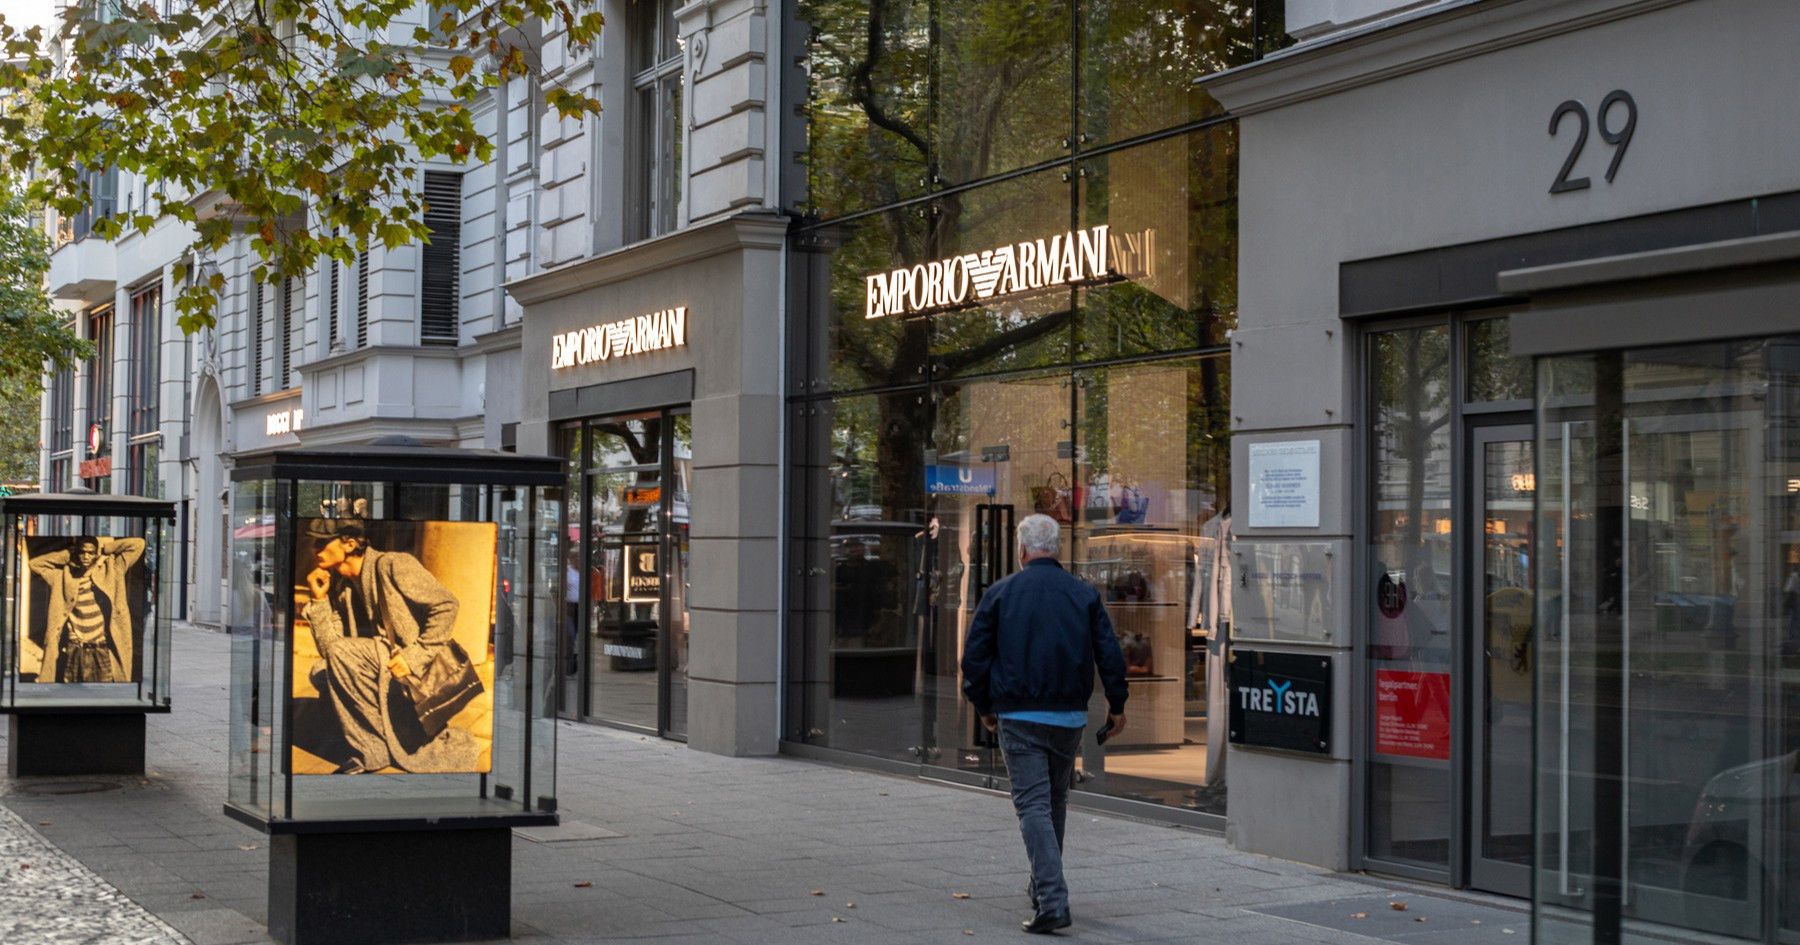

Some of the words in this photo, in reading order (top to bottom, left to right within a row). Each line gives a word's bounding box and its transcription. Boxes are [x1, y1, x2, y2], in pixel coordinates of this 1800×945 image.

[1547, 89, 1638, 194] 29
[864, 255, 969, 320] EMPORIO
[998, 224, 1110, 295] ARMANI
[551, 322, 611, 370] EMPORIO
[626, 306, 688, 354] ARMANI
[1238, 678, 1320, 717] TREYSTA
